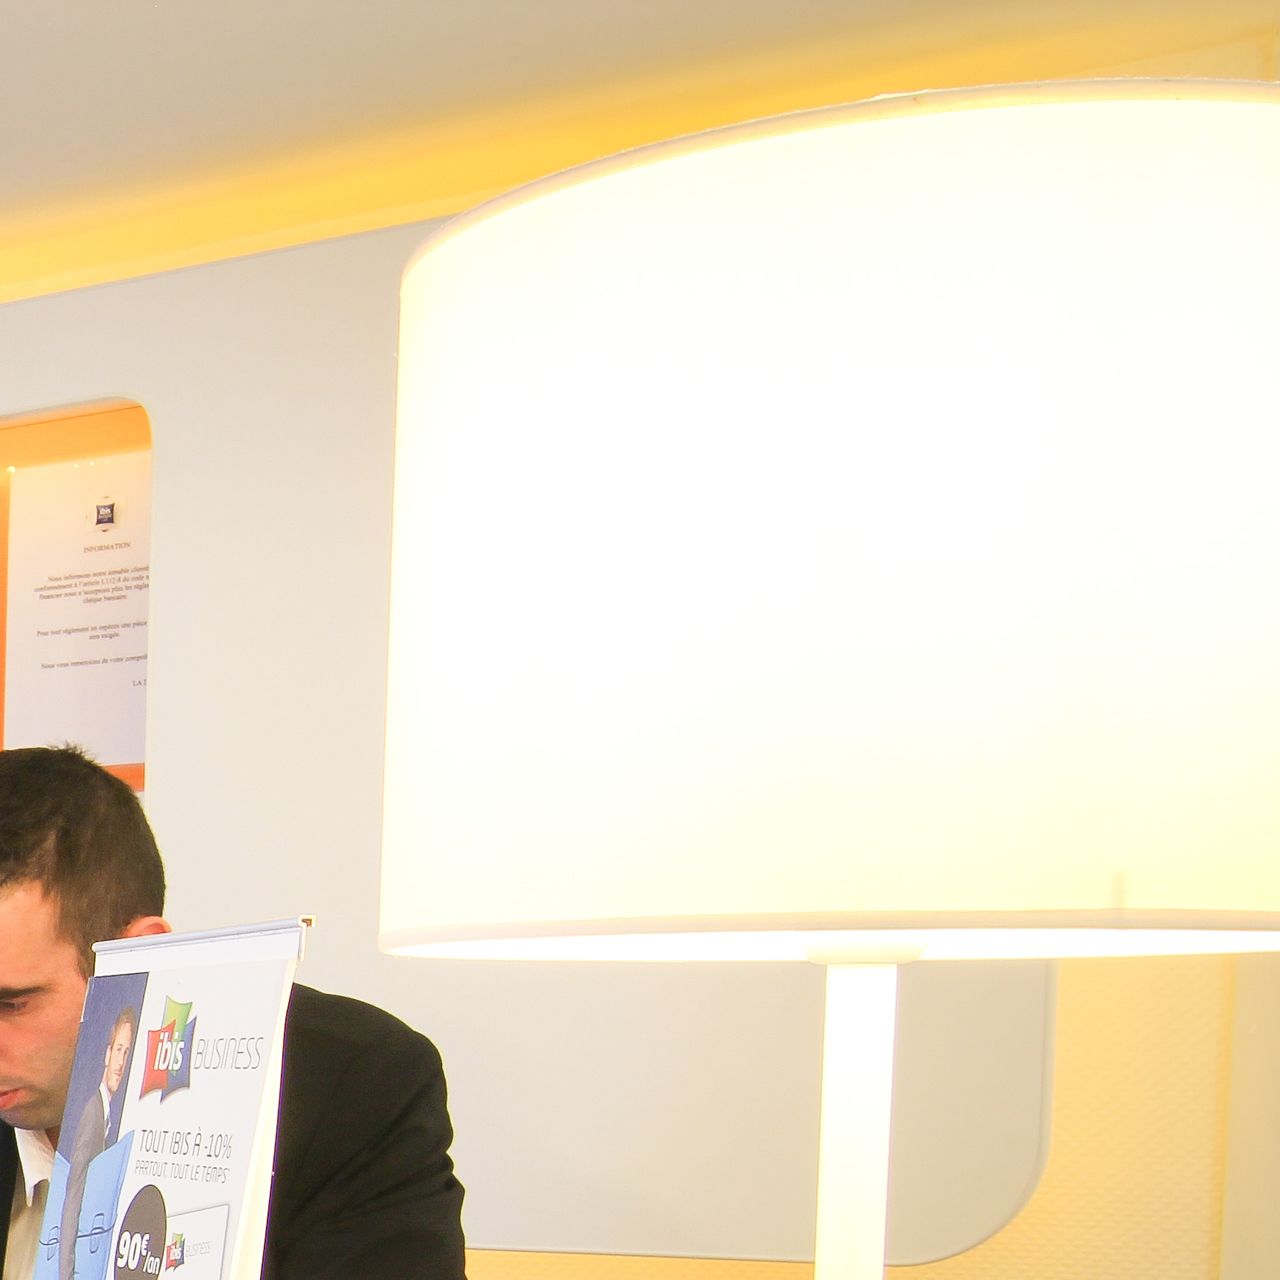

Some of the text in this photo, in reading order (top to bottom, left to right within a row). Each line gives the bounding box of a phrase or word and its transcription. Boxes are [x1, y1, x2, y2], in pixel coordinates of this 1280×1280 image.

[83, 542, 130, 553] INFORMATION
[153, 1032, 264, 1071] ibis BUSINESS
[140, 1125, 233, 1159] TOUT IBIS À -10%
[170, 1162, 190, 1181] TOUT
[190, 1164, 200, 1182] LE
